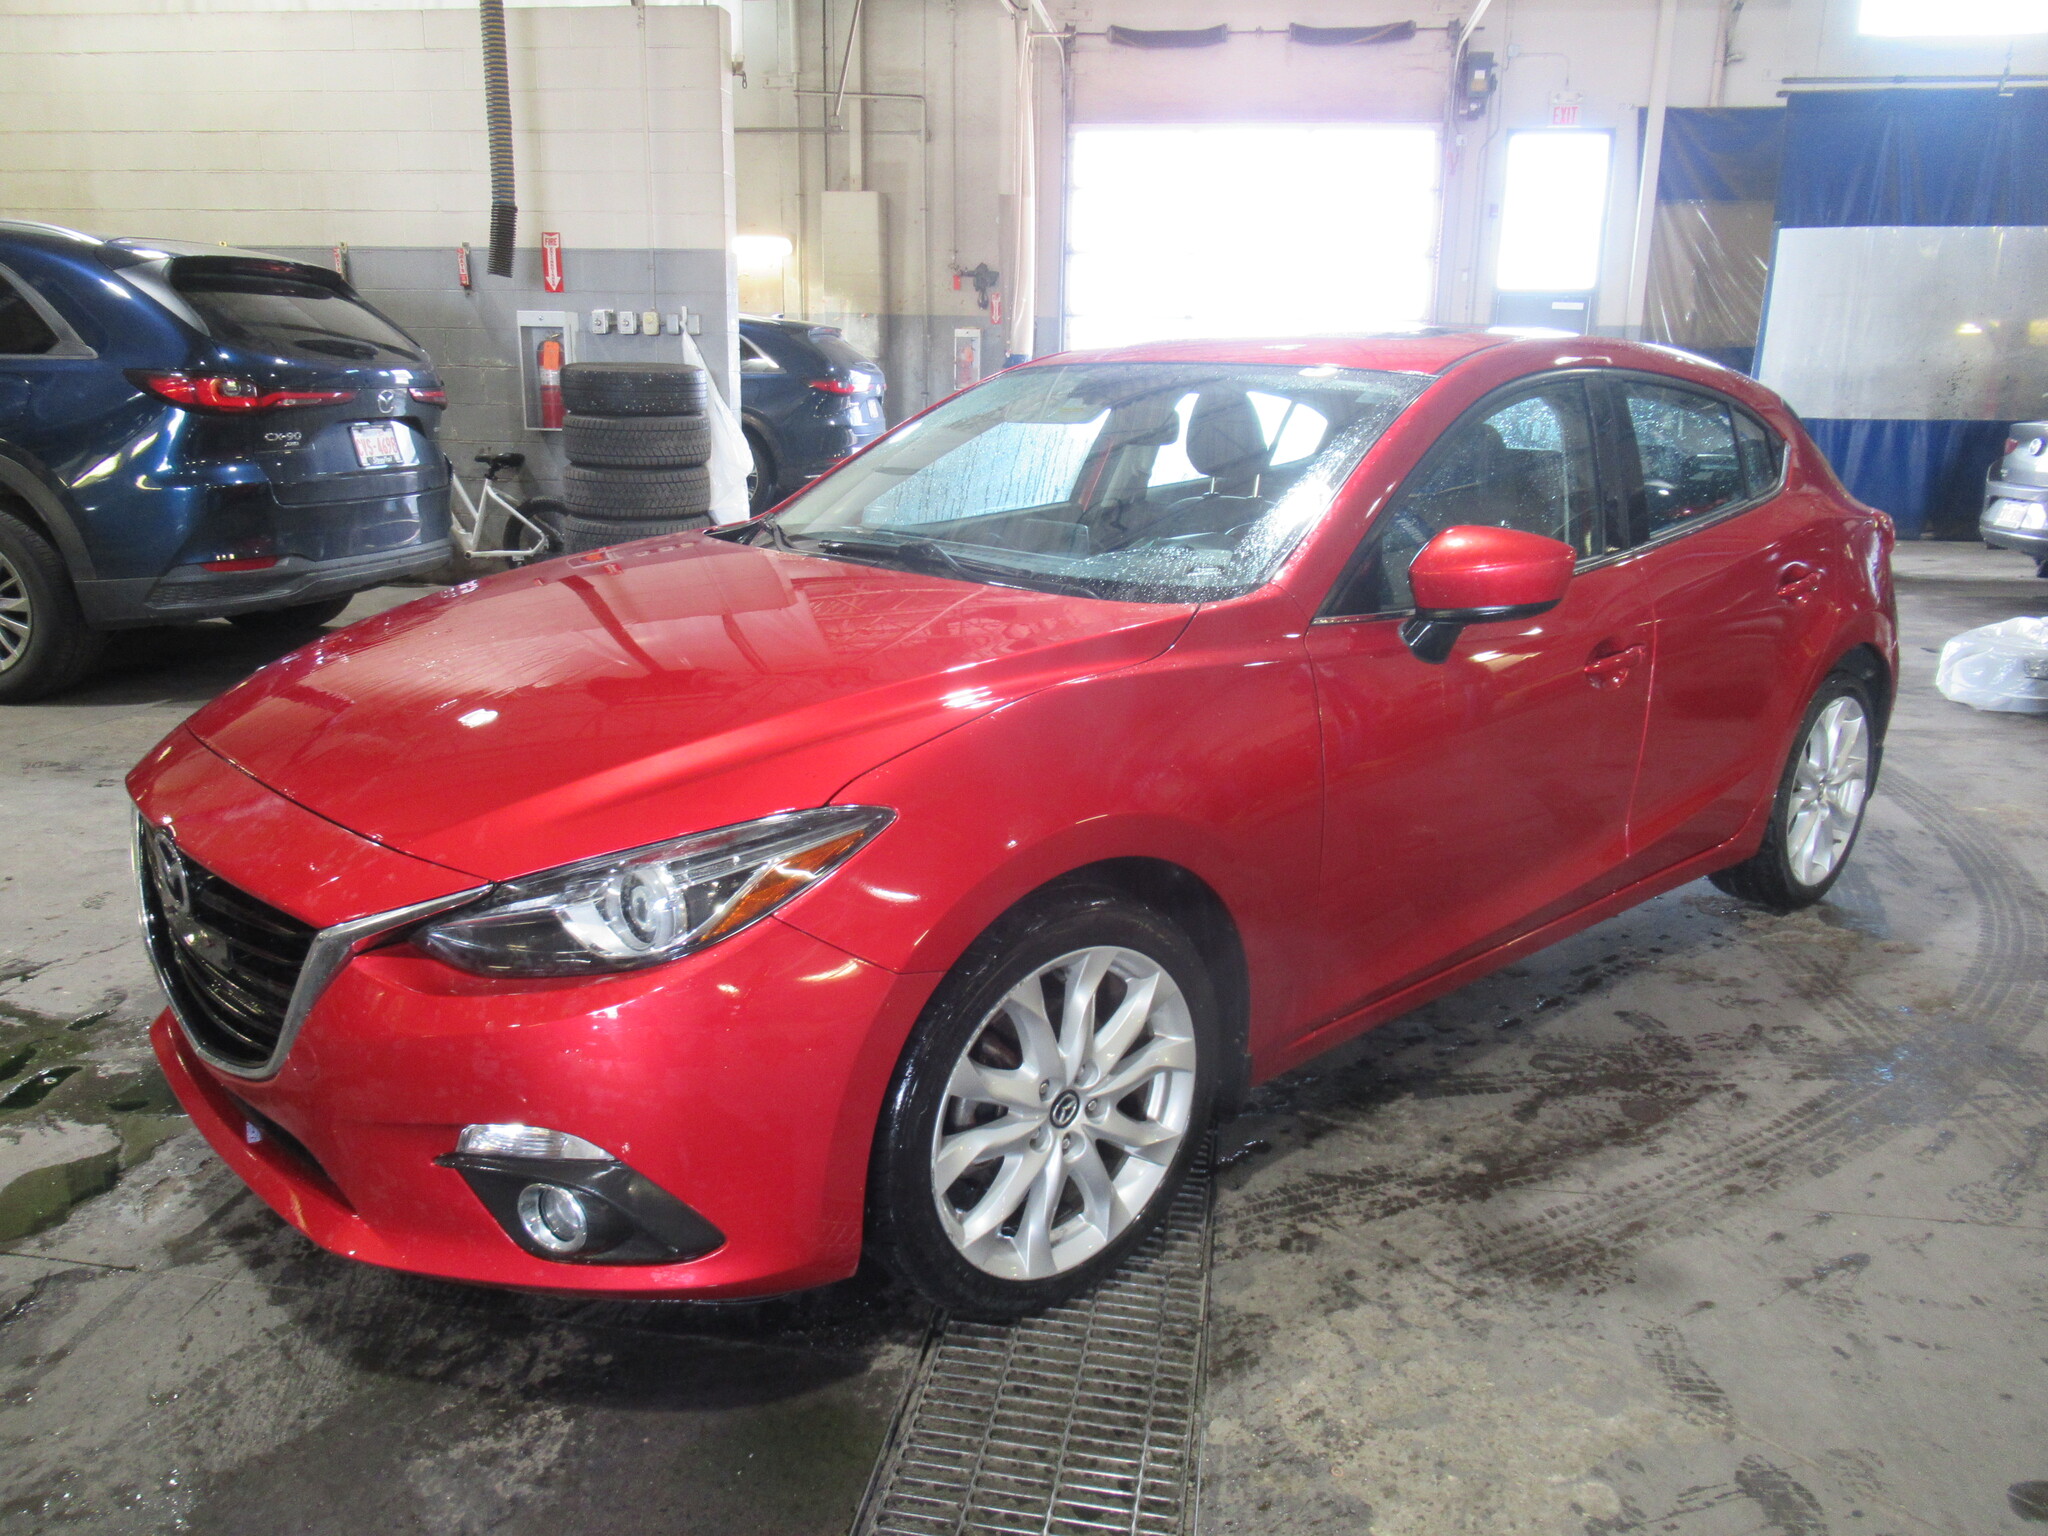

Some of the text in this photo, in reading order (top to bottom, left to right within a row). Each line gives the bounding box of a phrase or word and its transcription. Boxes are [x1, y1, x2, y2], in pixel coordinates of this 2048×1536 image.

[1552, 106, 1579, 125] EXIT
[545, 237, 557, 246] FIRE
[264, 431, 302, 441] CX-90
